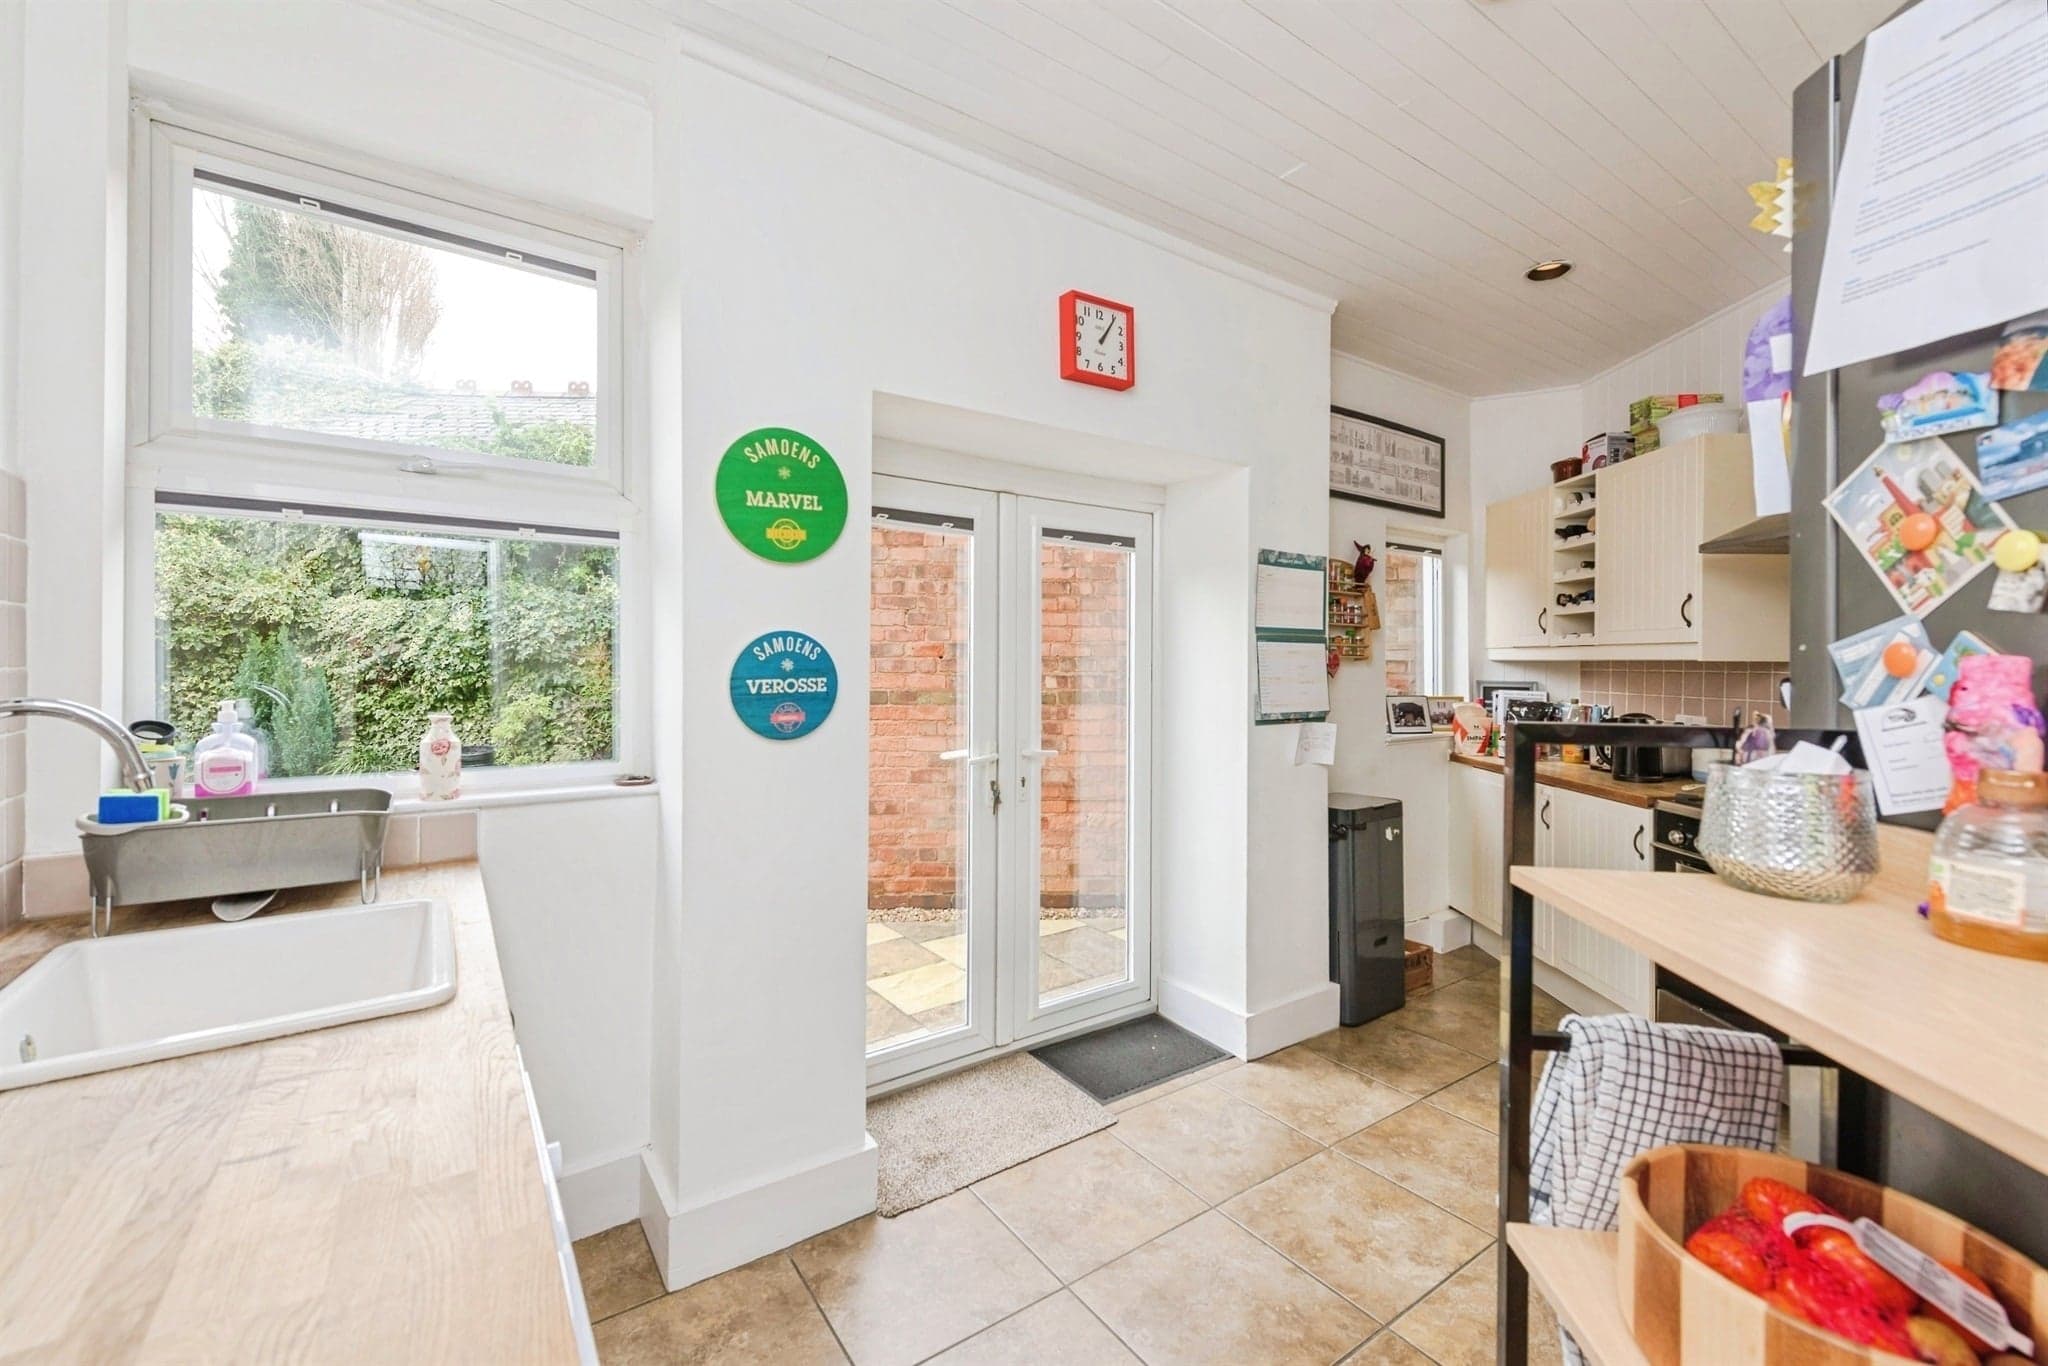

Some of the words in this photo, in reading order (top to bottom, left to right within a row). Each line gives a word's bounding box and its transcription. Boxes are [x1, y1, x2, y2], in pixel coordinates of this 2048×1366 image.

[1083, 306, 1091, 317] 11
[1095, 309, 1104, 321] 12
[1076, 331, 1082, 341] 9
[1118, 326, 1123, 336] 2
[1076, 346, 1082, 356] 8
[1119, 341, 1124, 351] 3
[1084, 359, 1090, 369] 7
[1097, 362, 1103, 372] 6
[1118, 358, 1123, 367] 4
[1111, 365, 1116, 375] 5
[743, 438, 820, 469] SAMOENS
[745, 489, 823, 511] MARVEL
[753, 636, 821, 661] SAMOENS
[745, 677, 828, 694] VEROSSE
